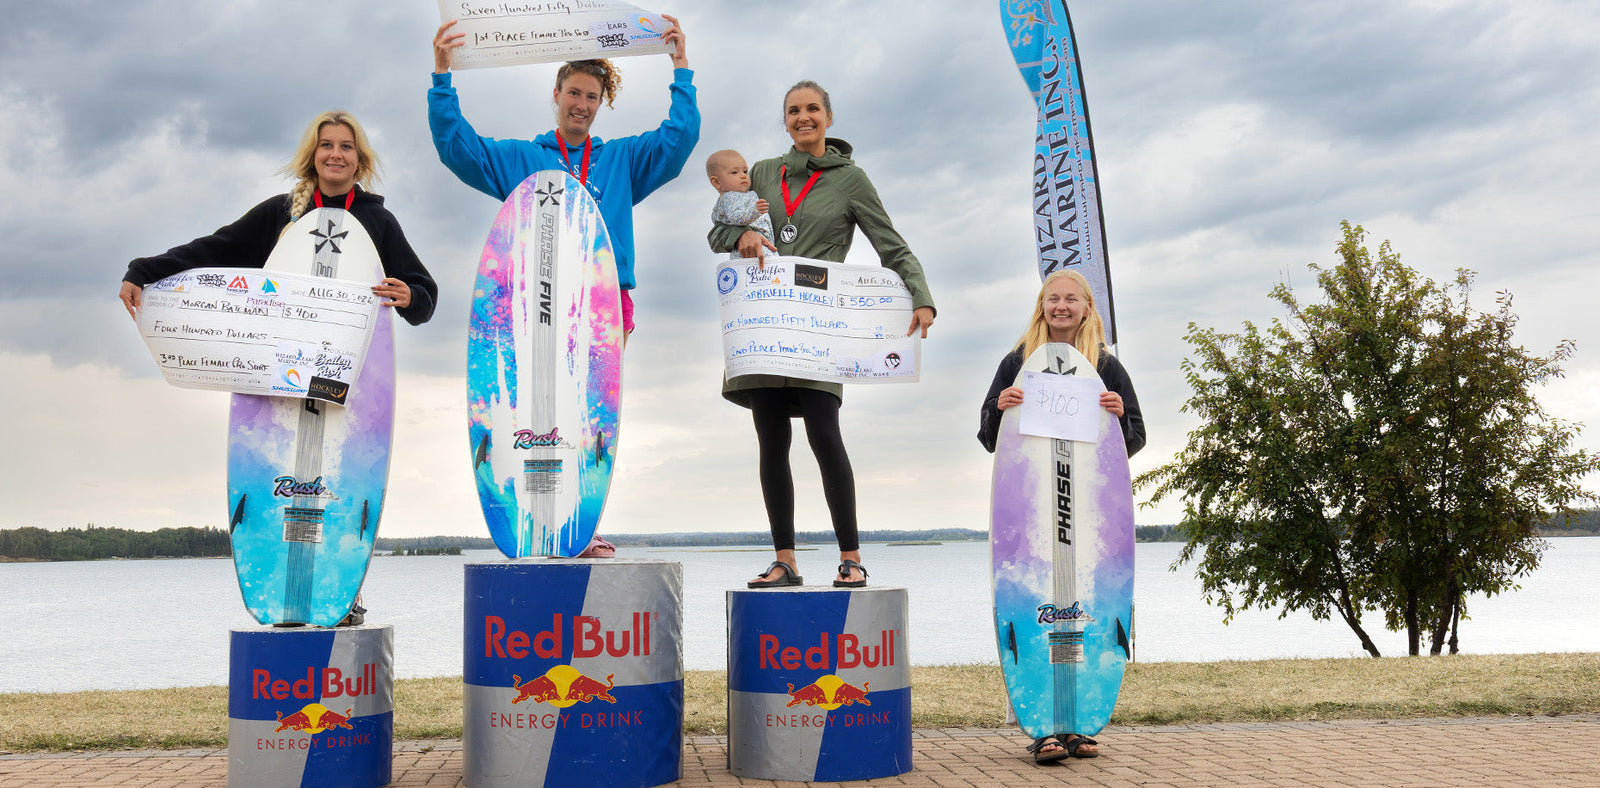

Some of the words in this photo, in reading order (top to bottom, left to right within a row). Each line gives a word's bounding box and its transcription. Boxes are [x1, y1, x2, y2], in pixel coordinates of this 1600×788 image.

[492, 31, 527, 43] PLACE
[1048, 124, 1082, 268] MARINE
[539, 213, 555, 279] PHASE
[246, 296, 286, 308] Paradise
[540, 280, 552, 326] FIVE
[737, 313, 779, 327] HUNDRED
[513, 427, 563, 450] Rush
[273, 476, 327, 498] Rush
[1056, 461, 1072, 546] PHASE
[1037, 600, 1083, 624] Rush
[485, 613, 563, 660] Red
[573, 611, 651, 660] Bull
[759, 632, 829, 671] Red
[837, 629, 895, 670] Bull
[252, 666, 315, 700] Red
[321, 662, 376, 699] Bull
[490, 712, 571, 729] ENERGY
[581, 710, 643, 729] DRINK
[766, 714, 837, 728] ENERGY
[844, 711, 891, 728] DRINK
[257, 738, 320, 750] ENERGY
[327, 733, 371, 749] DRINK
